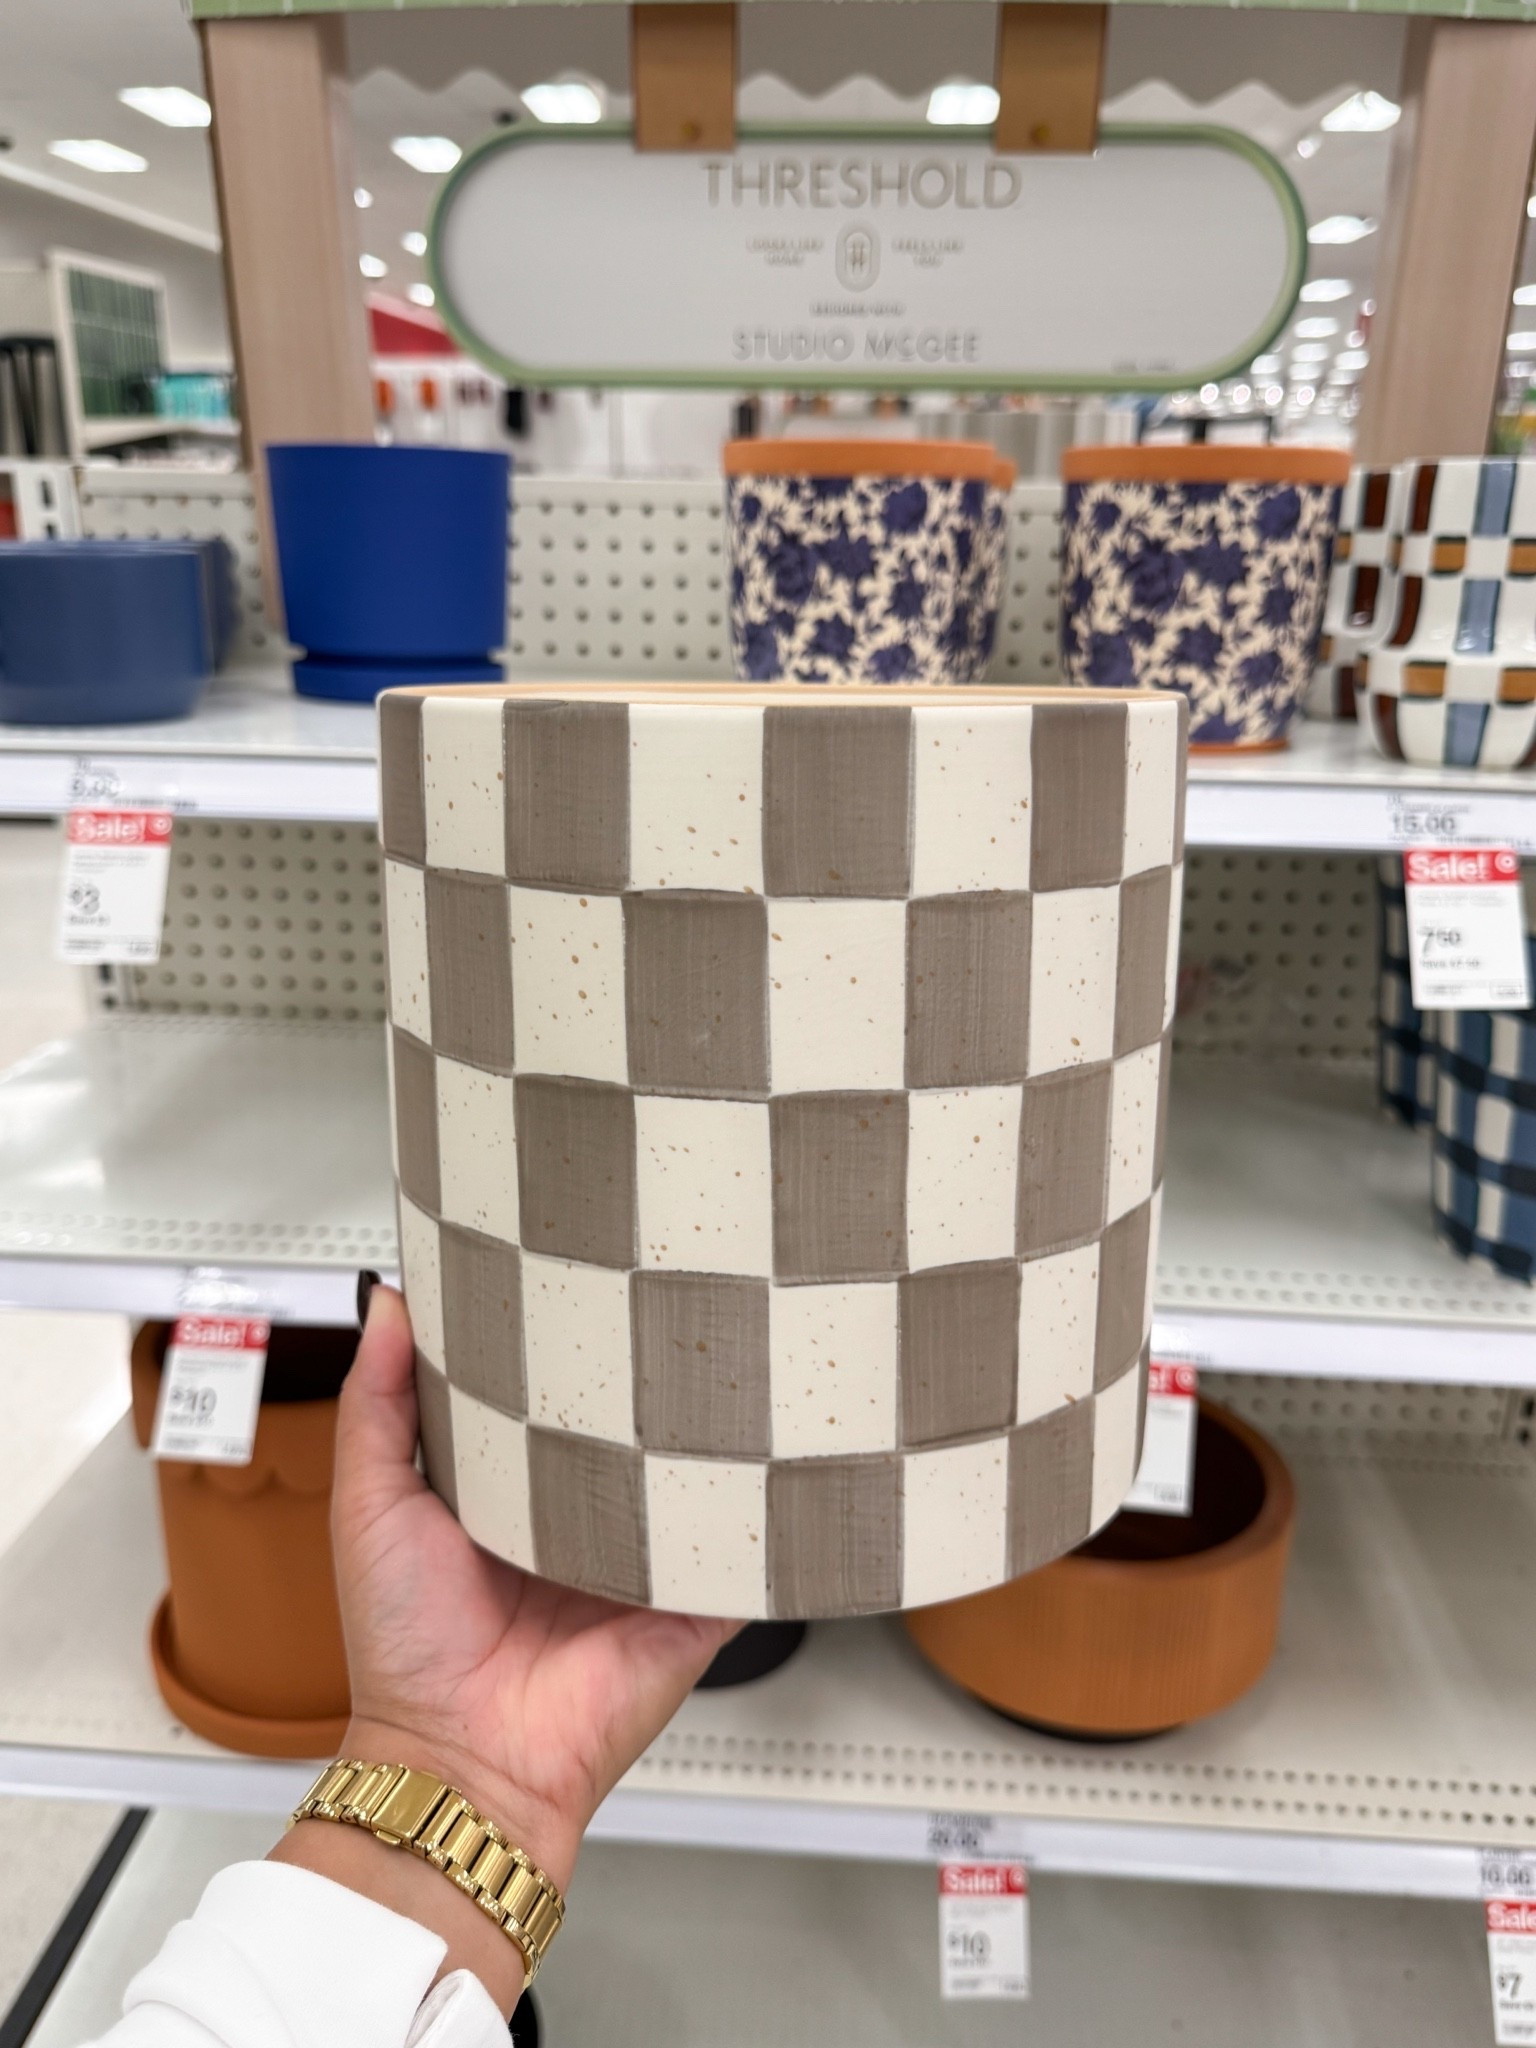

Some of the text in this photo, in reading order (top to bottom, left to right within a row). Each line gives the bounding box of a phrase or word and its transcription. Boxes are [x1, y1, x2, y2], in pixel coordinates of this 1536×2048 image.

[704, 156, 1023, 209] THRESHOLD
[732, 327, 855, 362] STUDIO
[70, 812, 147, 842] Sale!
[1392, 814, 1456, 836] 15.00
[1408, 851, 1490, 882] Sale!
[177, 1314, 247, 1347] Sale!
[943, 1865, 1006, 1894] Sale!
